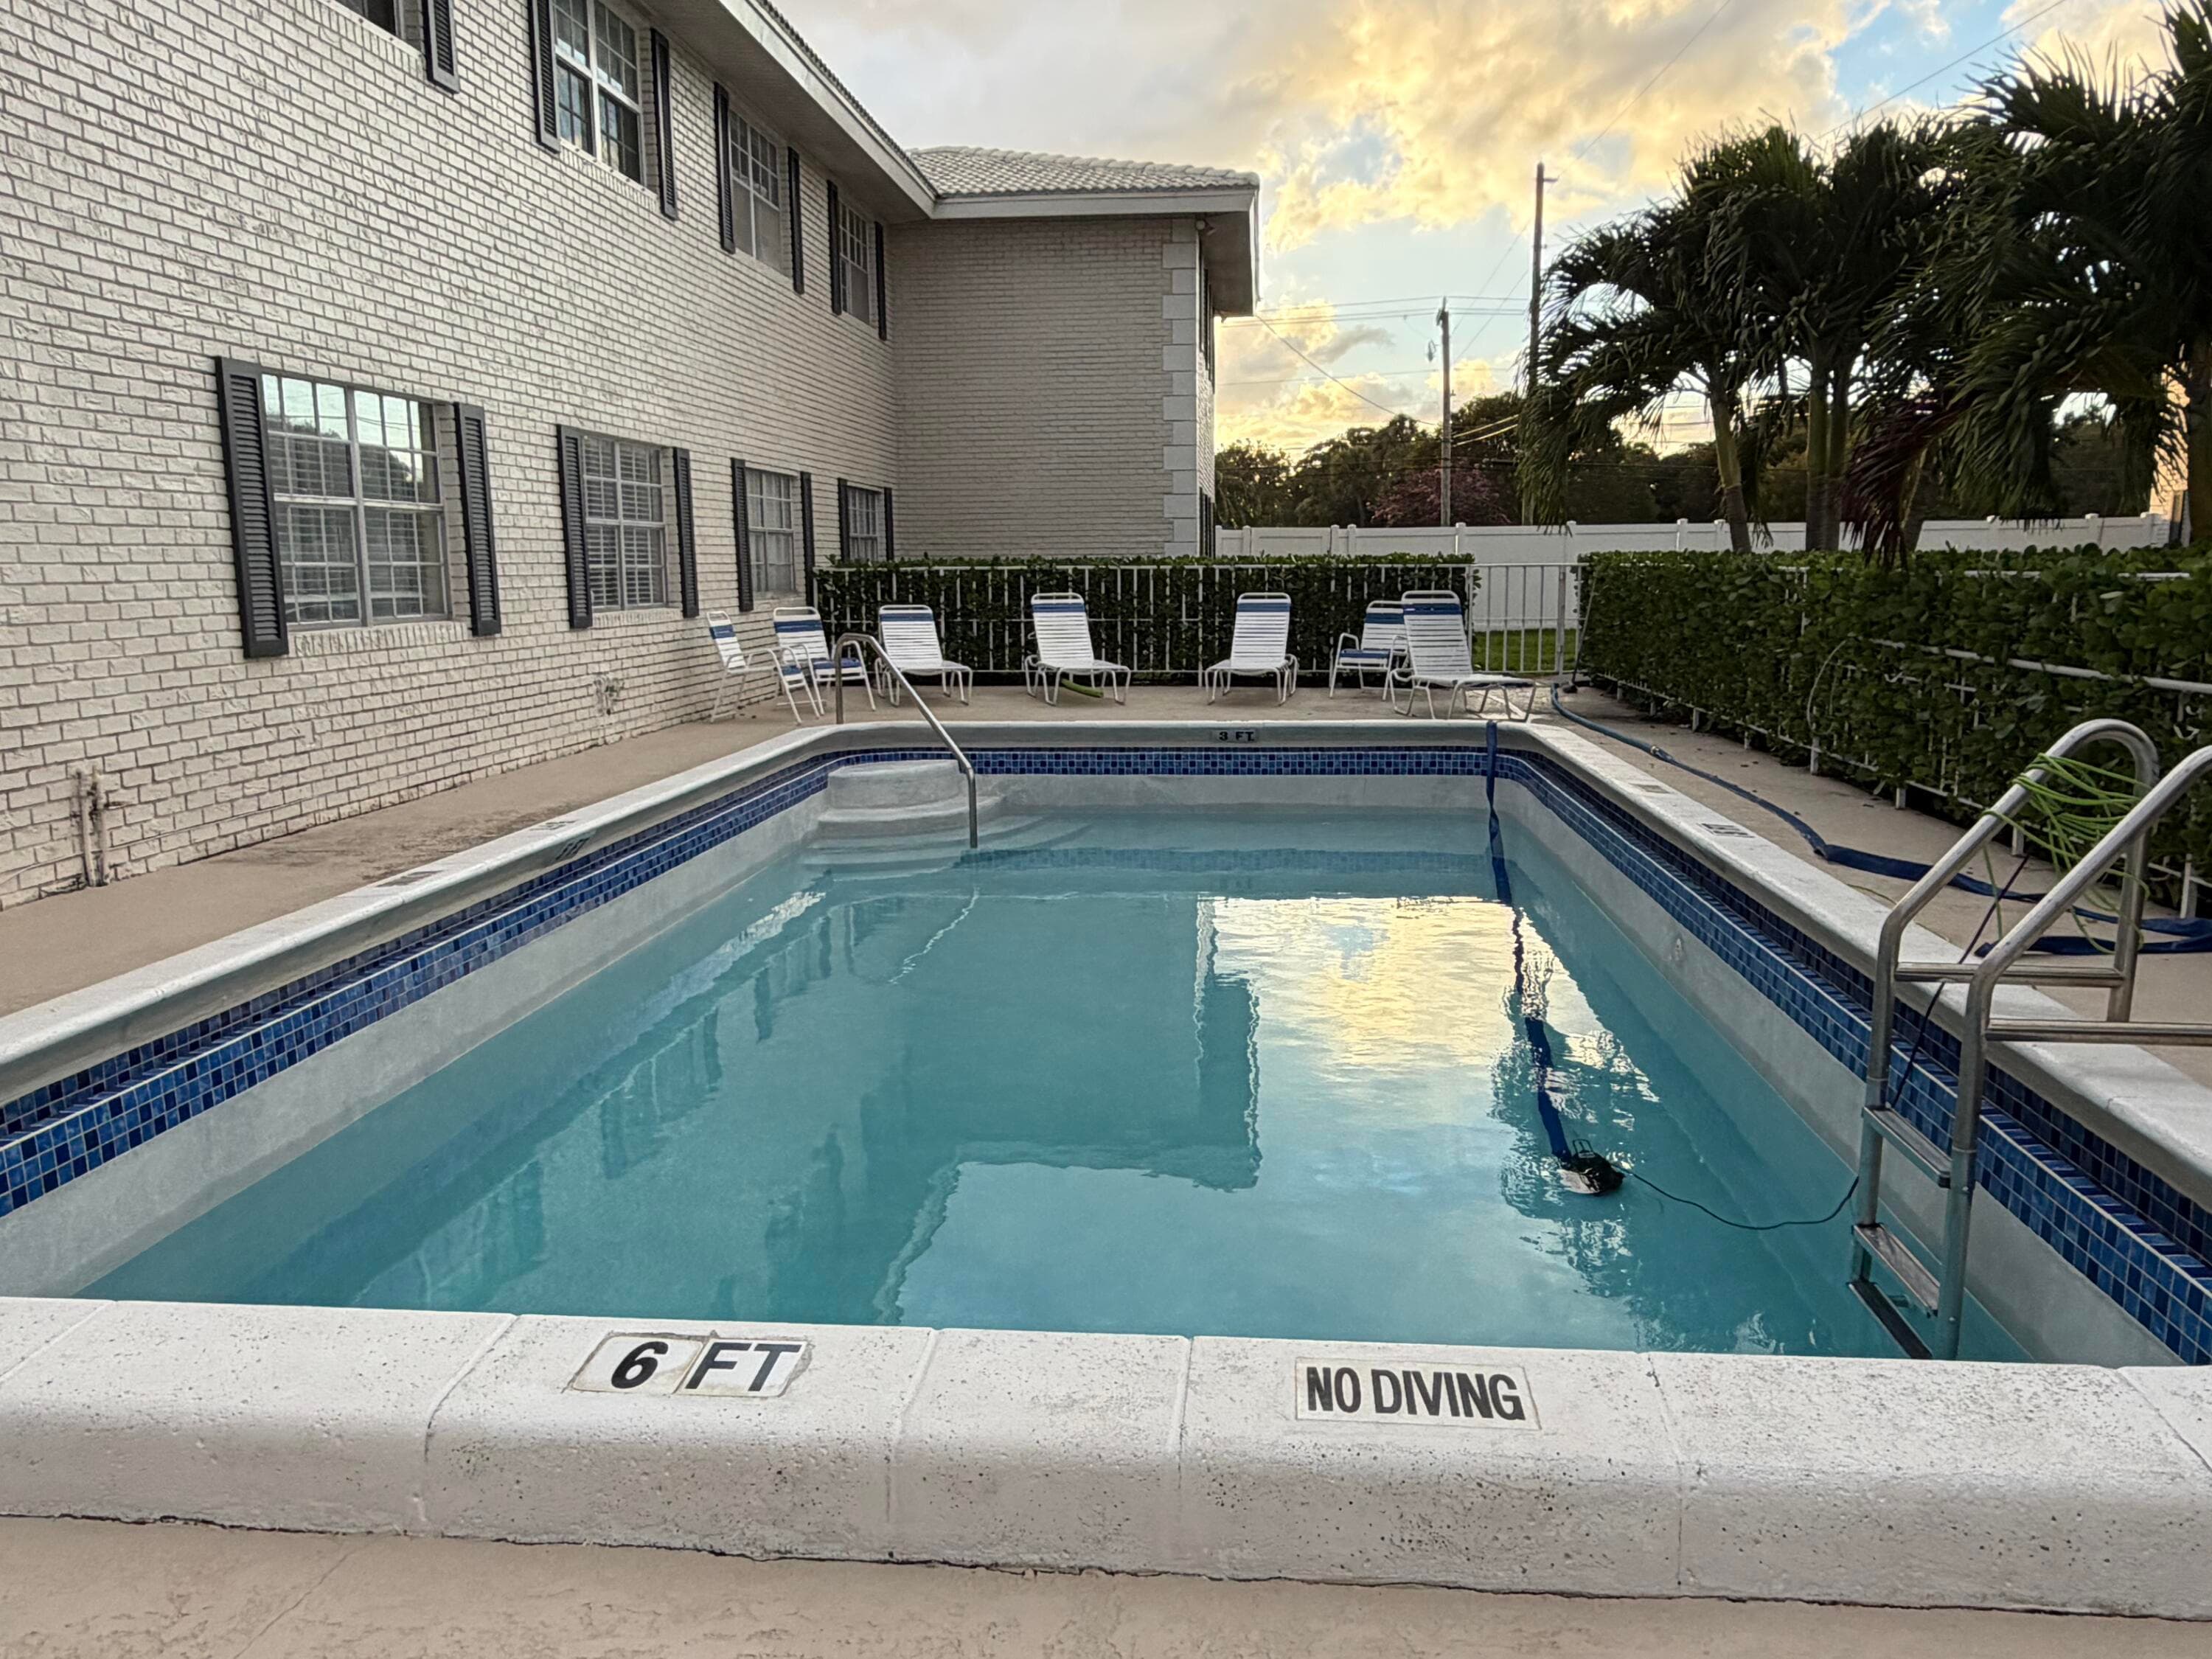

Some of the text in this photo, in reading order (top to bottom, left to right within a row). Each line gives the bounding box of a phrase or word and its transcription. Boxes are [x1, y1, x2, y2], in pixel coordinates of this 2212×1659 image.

[1219, 731, 1228, 741] 3
[611, 1341, 802, 1391] 6 FT
[1307, 1367, 1526, 1421] NO DIVING
